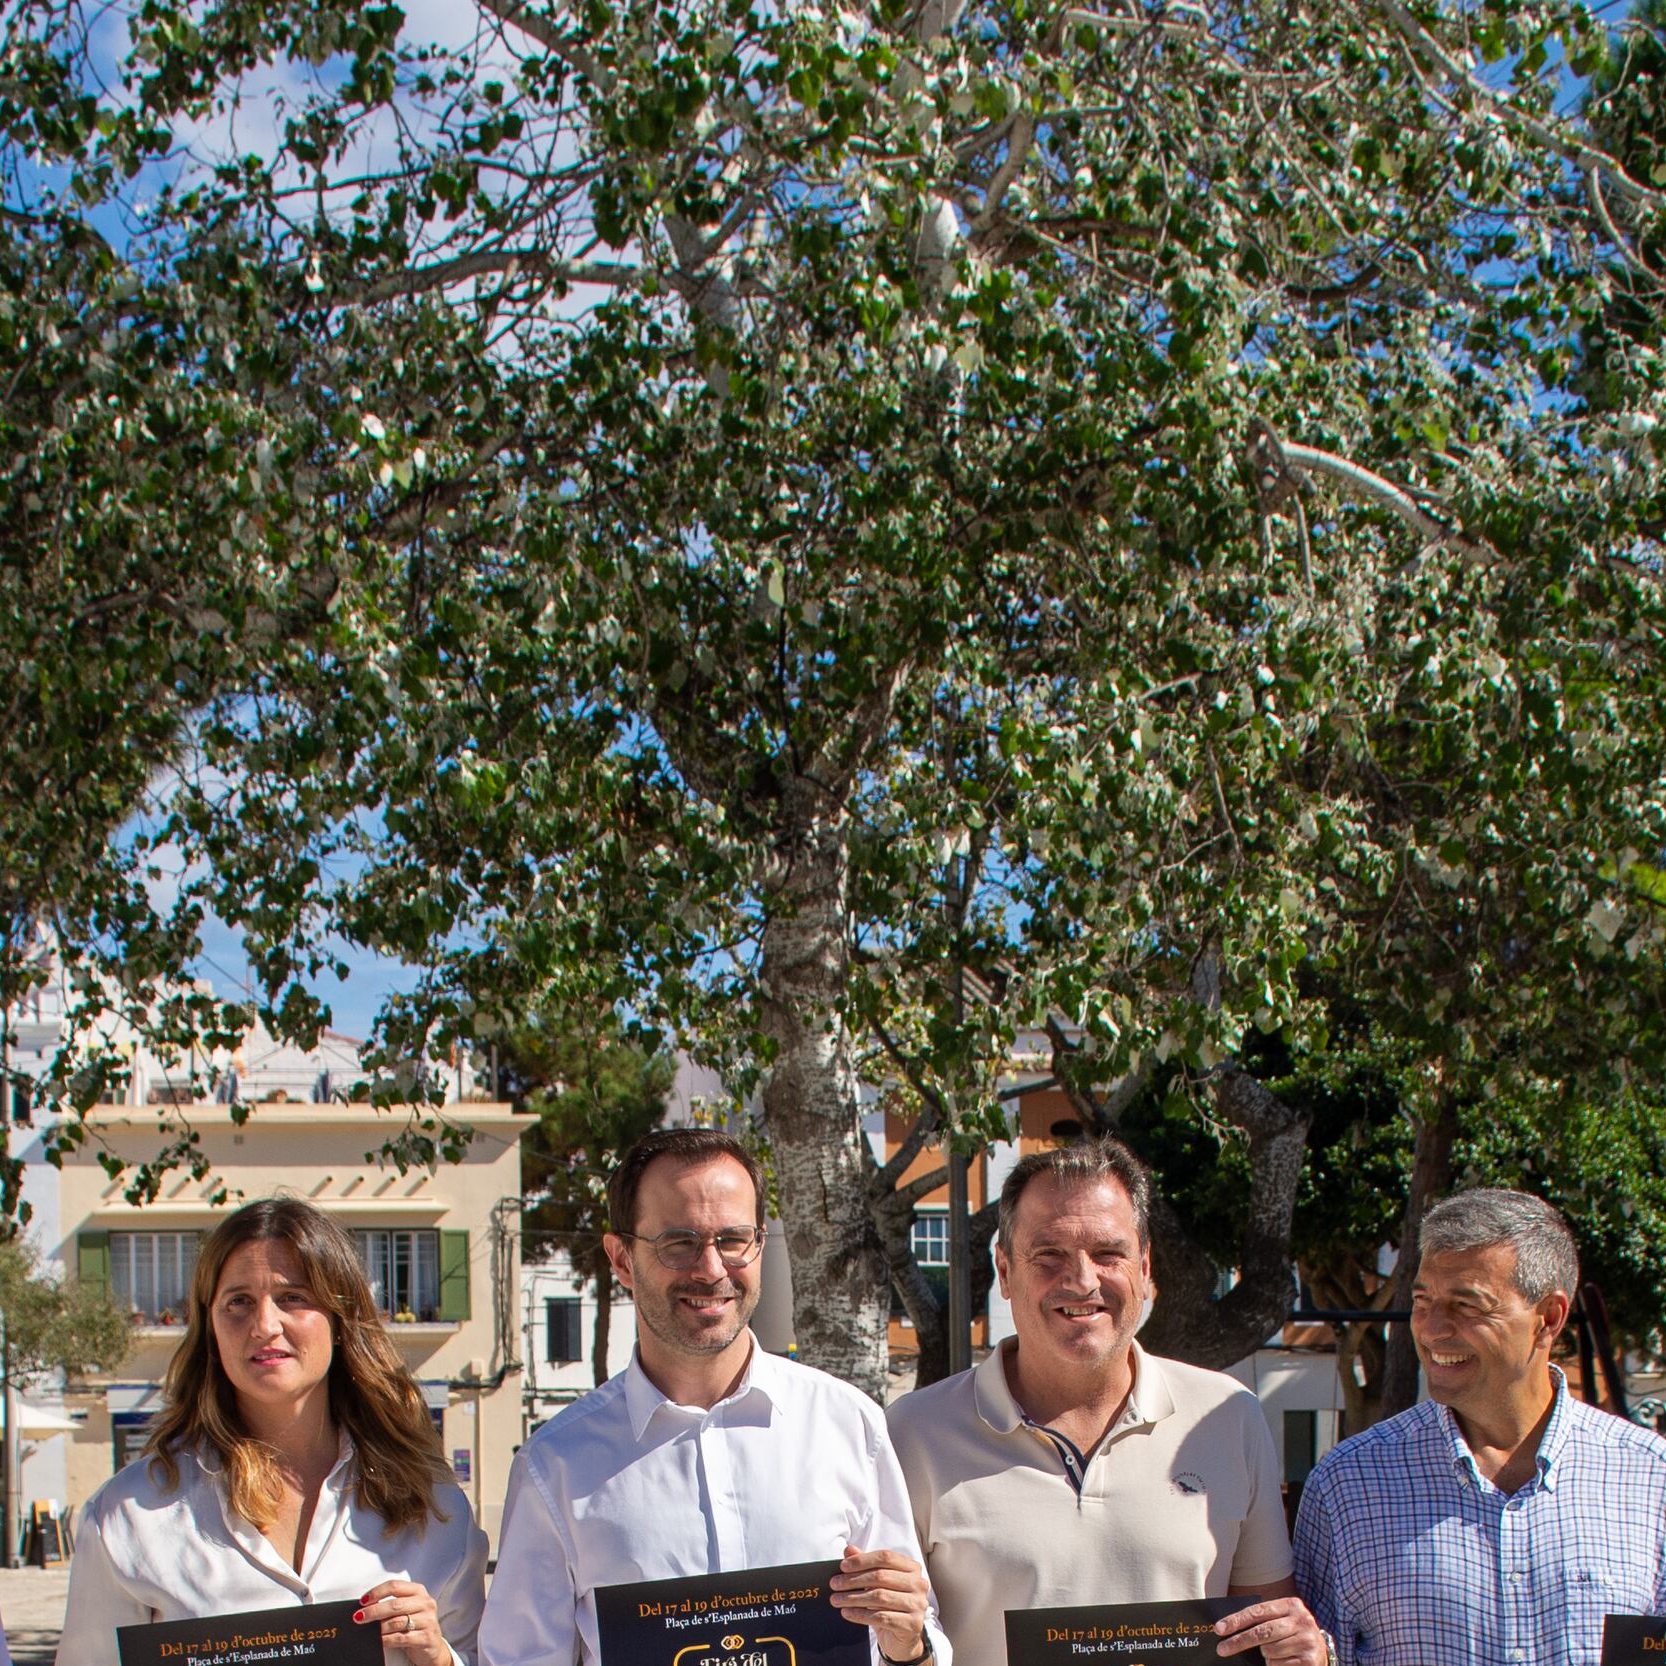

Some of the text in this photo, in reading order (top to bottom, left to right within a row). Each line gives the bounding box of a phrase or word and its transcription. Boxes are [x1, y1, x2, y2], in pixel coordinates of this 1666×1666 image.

[639, 1602, 662, 1617] Del
[665, 1604, 677, 1616] 17
[680, 1600, 690, 1612] al
[695, 1601, 707, 1612] 19
[772, 1589, 785, 1601] de
[789, 1587, 819, 1600] 2025
[665, 1618, 690, 1629] Plaça
[692, 1615, 702, 1625] de
[761, 1608, 772, 1617] de
[774, 1604, 796, 1615] Maó
[160, 1643, 182, 1656] Del
[186, 1644, 198, 1654] 17
[202, 1640, 212, 1652] al
[215, 1641, 228, 1651] 19
[291, 1629, 304, 1641] de
[308, 1627, 337, 1640] 2025
[1047, 1628, 1068, 1641] Del
[1072, 1631, 1084, 1642] 17
[1088, 1627, 1098, 1639] al
[1101, 1630, 1113, 1640] 19
[1176, 1622, 1189, 1634] de
[1193, 1624, 1215, 1634] 202
[1072, 1644, 1095, 1654] Plaça
[1097, 1642, 1108, 1652] de
[1165, 1639, 1176, 1649] de
[1178, 1637, 1199, 1647] Maó
[1642, 1636, 1664, 1651] Del
[213, 1655, 223, 1664] de
[280, 1648, 291, 1657] de
[293, 1644, 315, 1655] Maó
